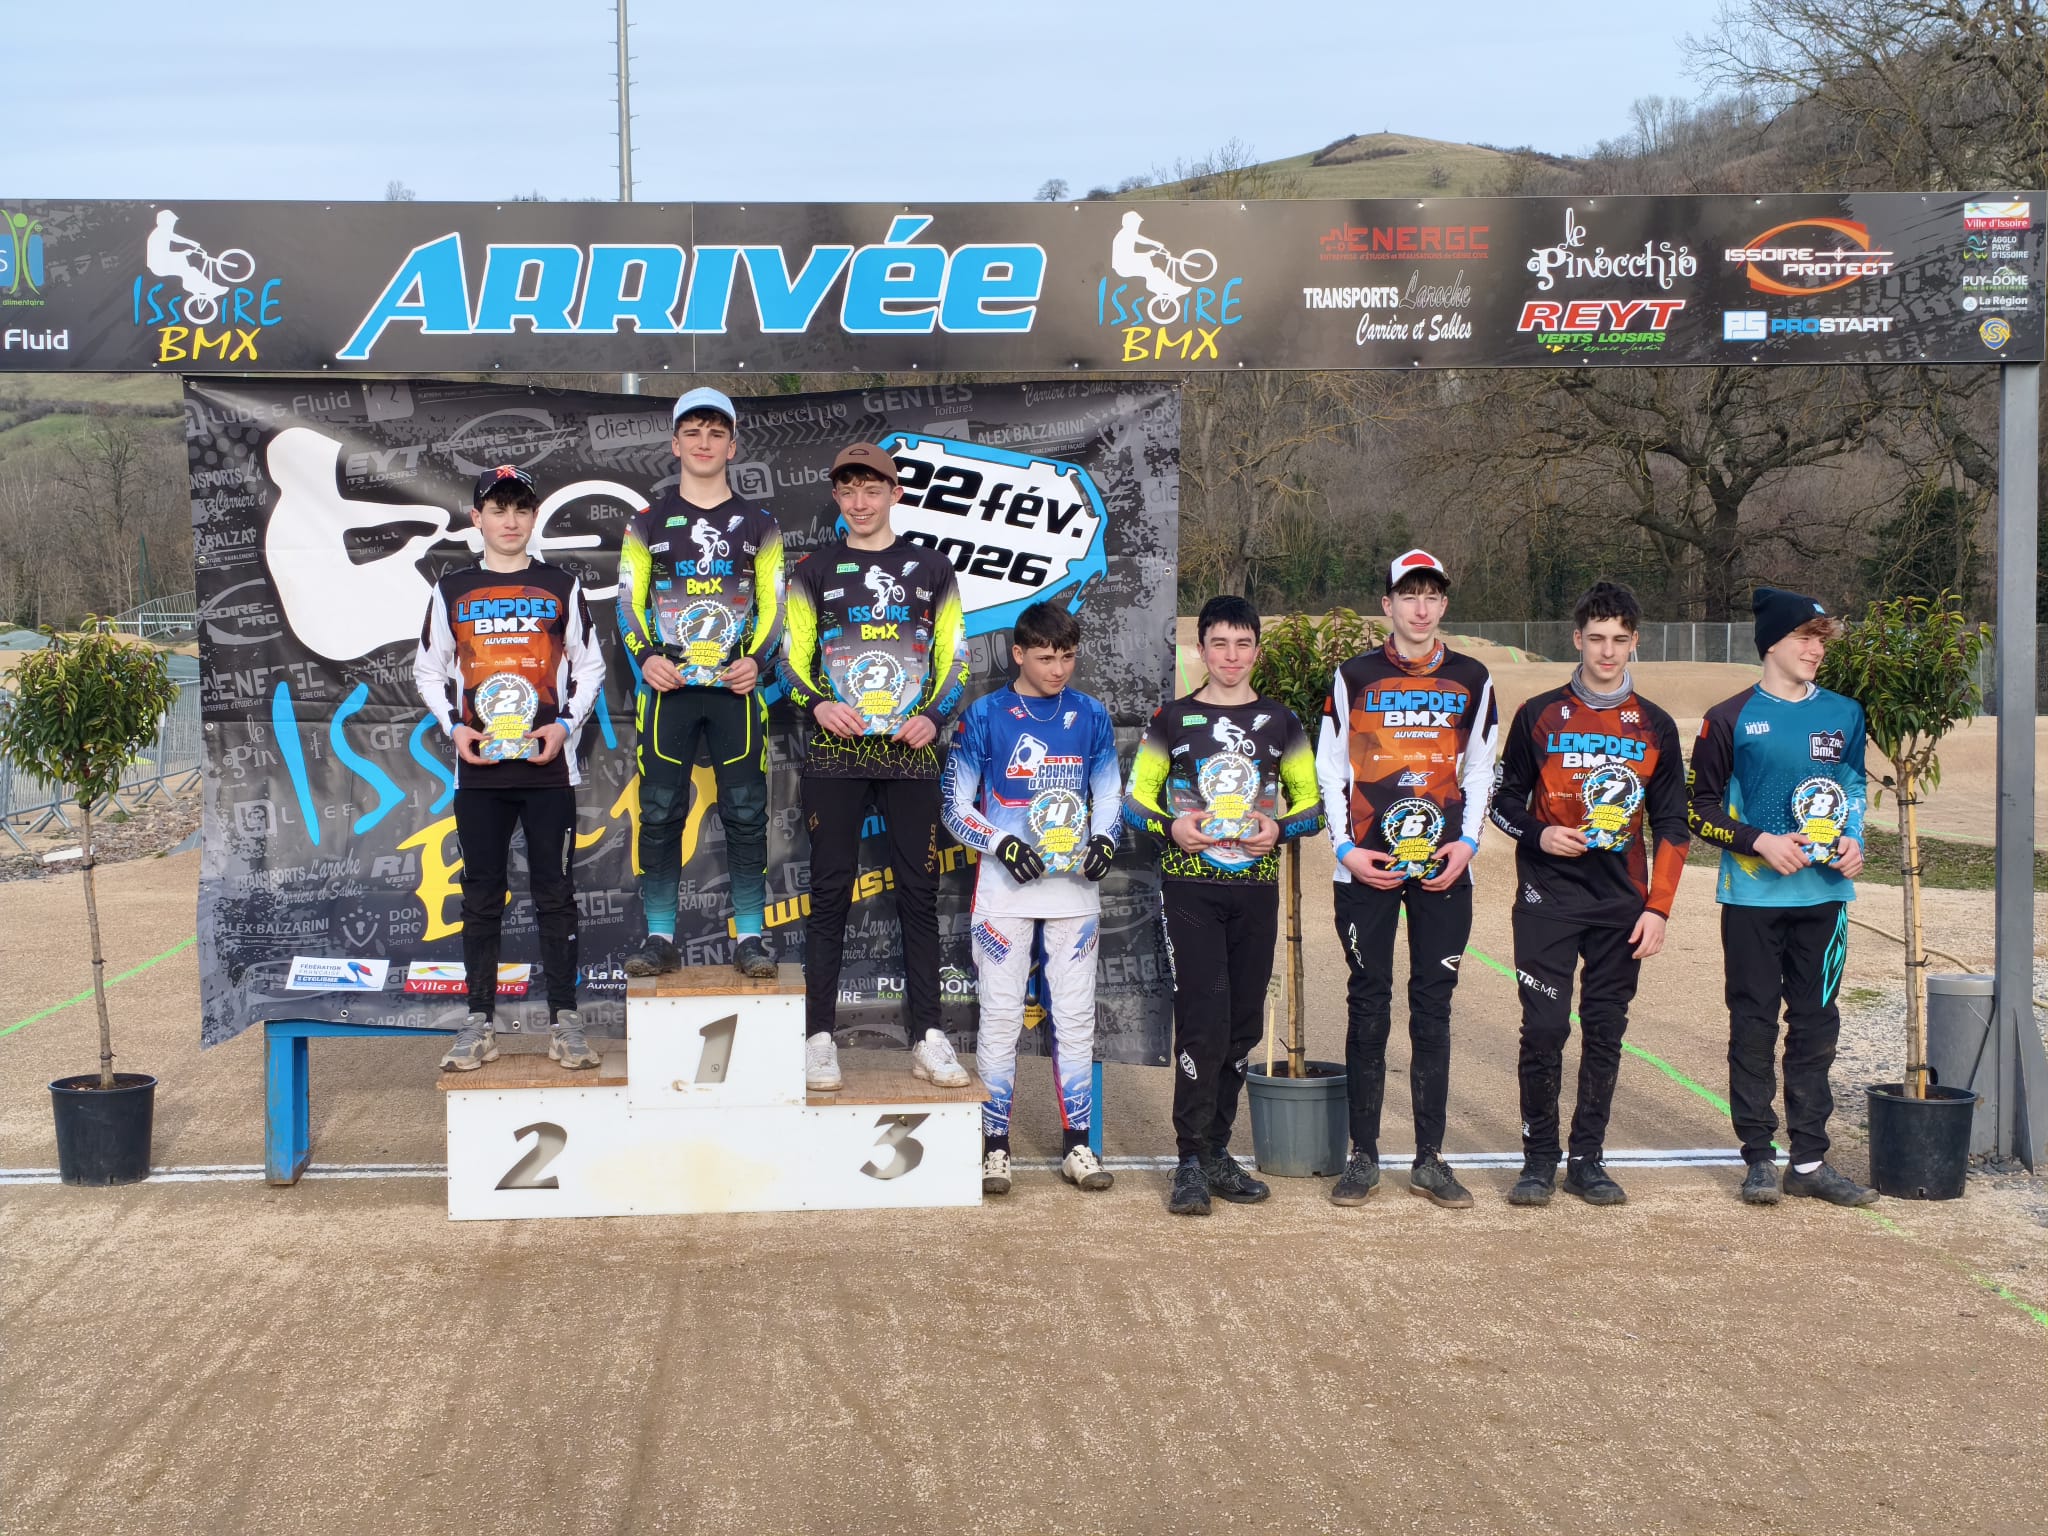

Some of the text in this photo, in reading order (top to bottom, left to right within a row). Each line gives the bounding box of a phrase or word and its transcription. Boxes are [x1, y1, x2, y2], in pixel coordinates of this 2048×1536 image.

[1966, 218, 2028, 229] Ville d'Issoire
[1991, 235, 2017, 244] AGGLO
[1991, 243, 2011, 251] PAYS
[1724, 248, 1814, 262] ISSOIRE
[1991, 251, 2029, 259] D'ISSOIRE
[1782, 262, 1894, 277] PROTECT
[1303, 286, 1399, 309] TRANSPORTS
[1979, 295, 2029, 307] La Région
[1516, 299, 1687, 332] REYT
[1770, 317, 1894, 334] PROSTART
[4, 328, 69, 350] Fluid
[1355, 311, 1473, 346] Carrière et Sables
[1537, 332, 1667, 344] VERTS LOISIRS
[157, 325, 259, 363] BMX
[1121, 325, 1221, 363] BMX
[208, 405, 266, 425] Lube
[292, 390, 352, 414] Fluid
[933, 404, 974, 417] Toitures
[977, 418, 1086, 446] ALEX BALZARINI
[894, 455, 983, 517] 22
[979, 482, 1083, 539] fév.
[456, 597, 558, 623] LEMPDES
[847, 604, 912, 624] ISSOIRE
[474, 617, 542, 635] BMX
[697, 616, 716, 639] 1
[483, 636, 530, 646] AUVERGNE
[863, 665, 889, 689] 3
[493, 689, 521, 714] 2
[1364, 689, 1468, 715] LEMPDES
[1383, 710, 1454, 729] BMX
[1393, 730, 1440, 739] AUVERGNE
[1546, 732, 1647, 762] LEMPDES
[1600, 779, 1627, 804] 7
[1045, 802, 1070, 826] 4
[1595, 804, 1627, 817] COUPE
[1809, 793, 1835, 817] 8
[1400, 815, 1428, 838] 6
[1398, 837, 1430, 848] COUPE
[1399, 853, 1429, 862] 2026
[257, 917, 330, 935] BALZARINI
[588, 969, 608, 980] La
[409, 981, 447, 992] Ville
[695, 1013, 738, 1084] 1
[494, 1121, 568, 1191] 2
[858, 1113, 931, 1181] 3
